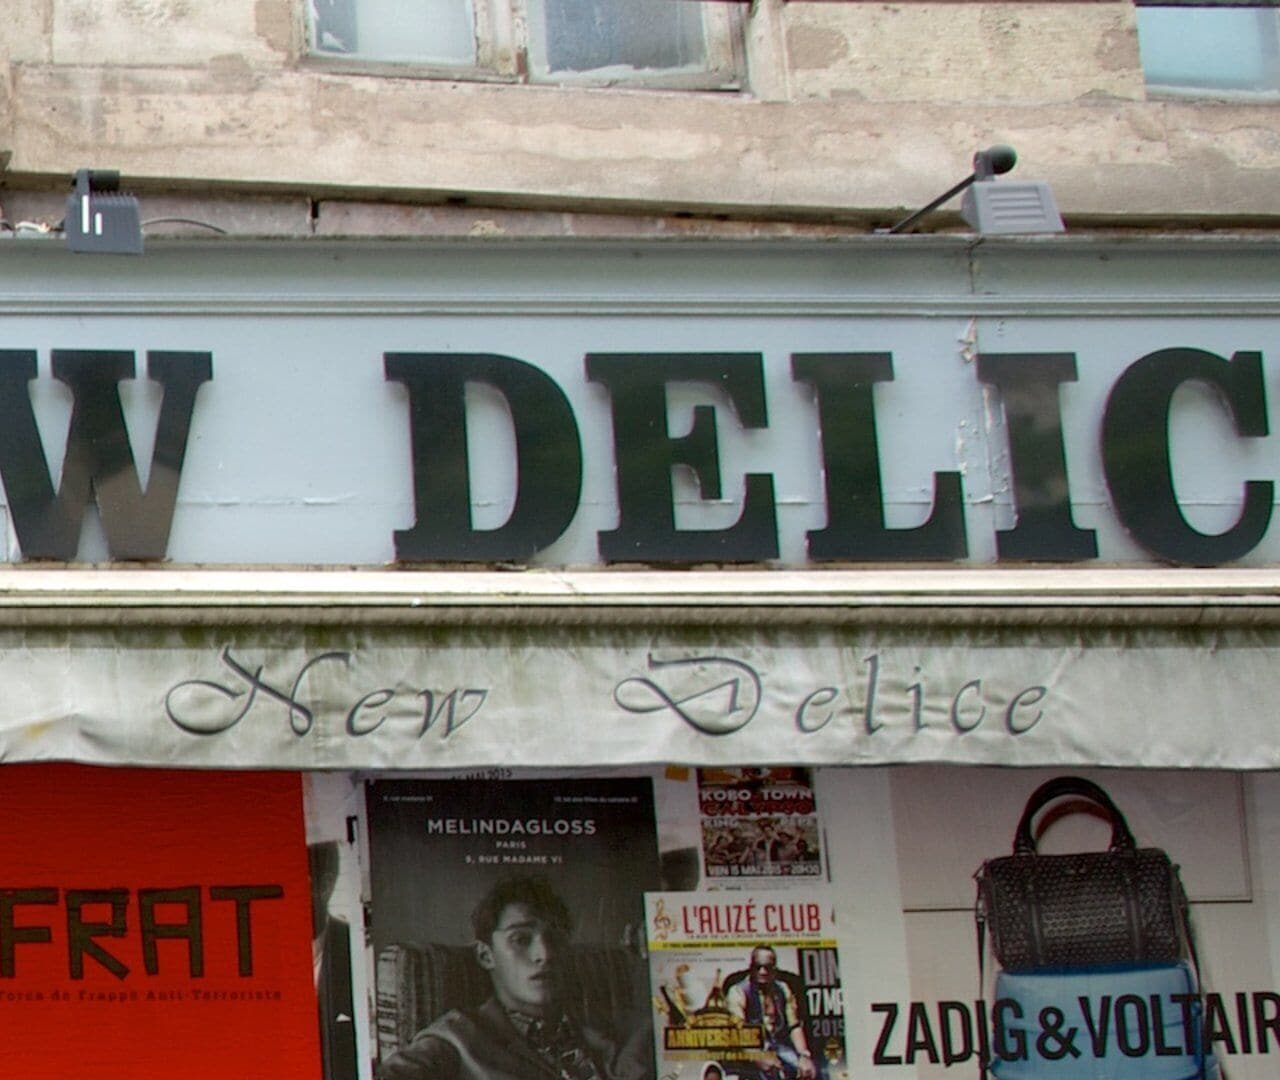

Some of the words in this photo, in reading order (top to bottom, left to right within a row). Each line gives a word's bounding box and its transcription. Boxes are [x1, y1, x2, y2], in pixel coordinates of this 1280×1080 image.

[383, 348, 1276, 566] DELIC
[165, 645, 487, 740] New
[613, 651, 1049, 738] Delice
[761, 788, 812, 800] TOWN
[427, 819, 596, 835] MELINDAGLOSS
[496, 841, 527, 849] PARIS
[479, 855, 499, 864] RUE
[503, 855, 547, 864] MADAME
[682, 898, 756, 933] L'ALIZÉ
[765, 904, 821, 932] CLUB
